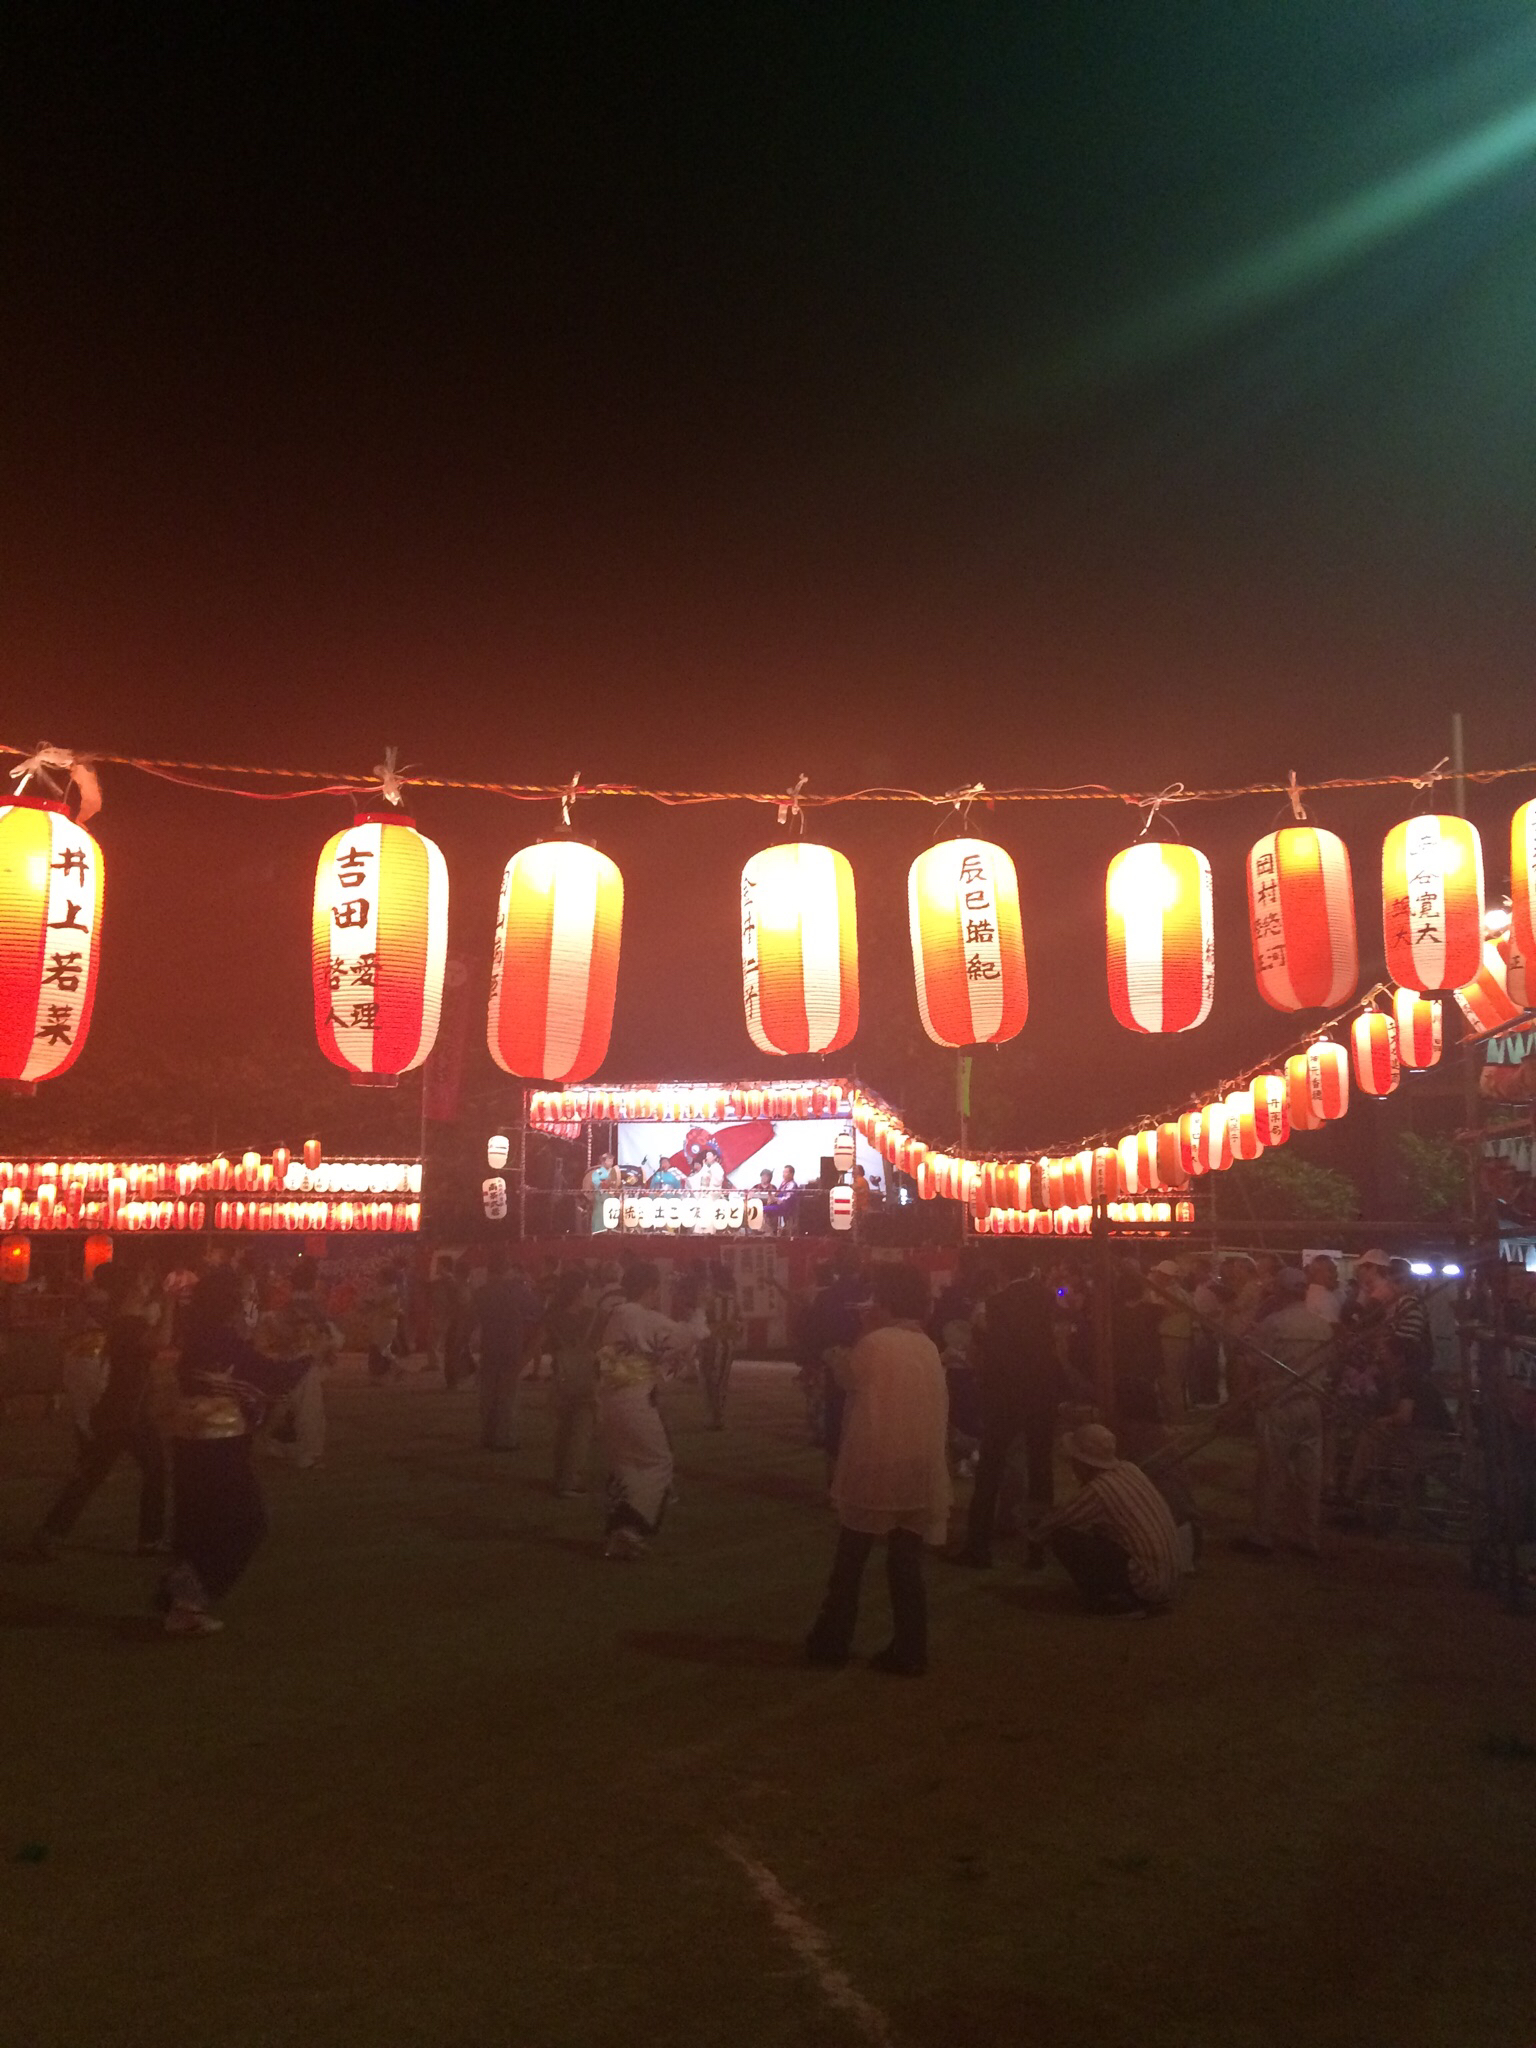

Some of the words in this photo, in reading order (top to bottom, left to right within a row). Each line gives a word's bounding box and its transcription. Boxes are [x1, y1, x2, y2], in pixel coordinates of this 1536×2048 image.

[35, 846, 90, 1046] 井上若菜
[332, 845, 374, 930] 吉田
